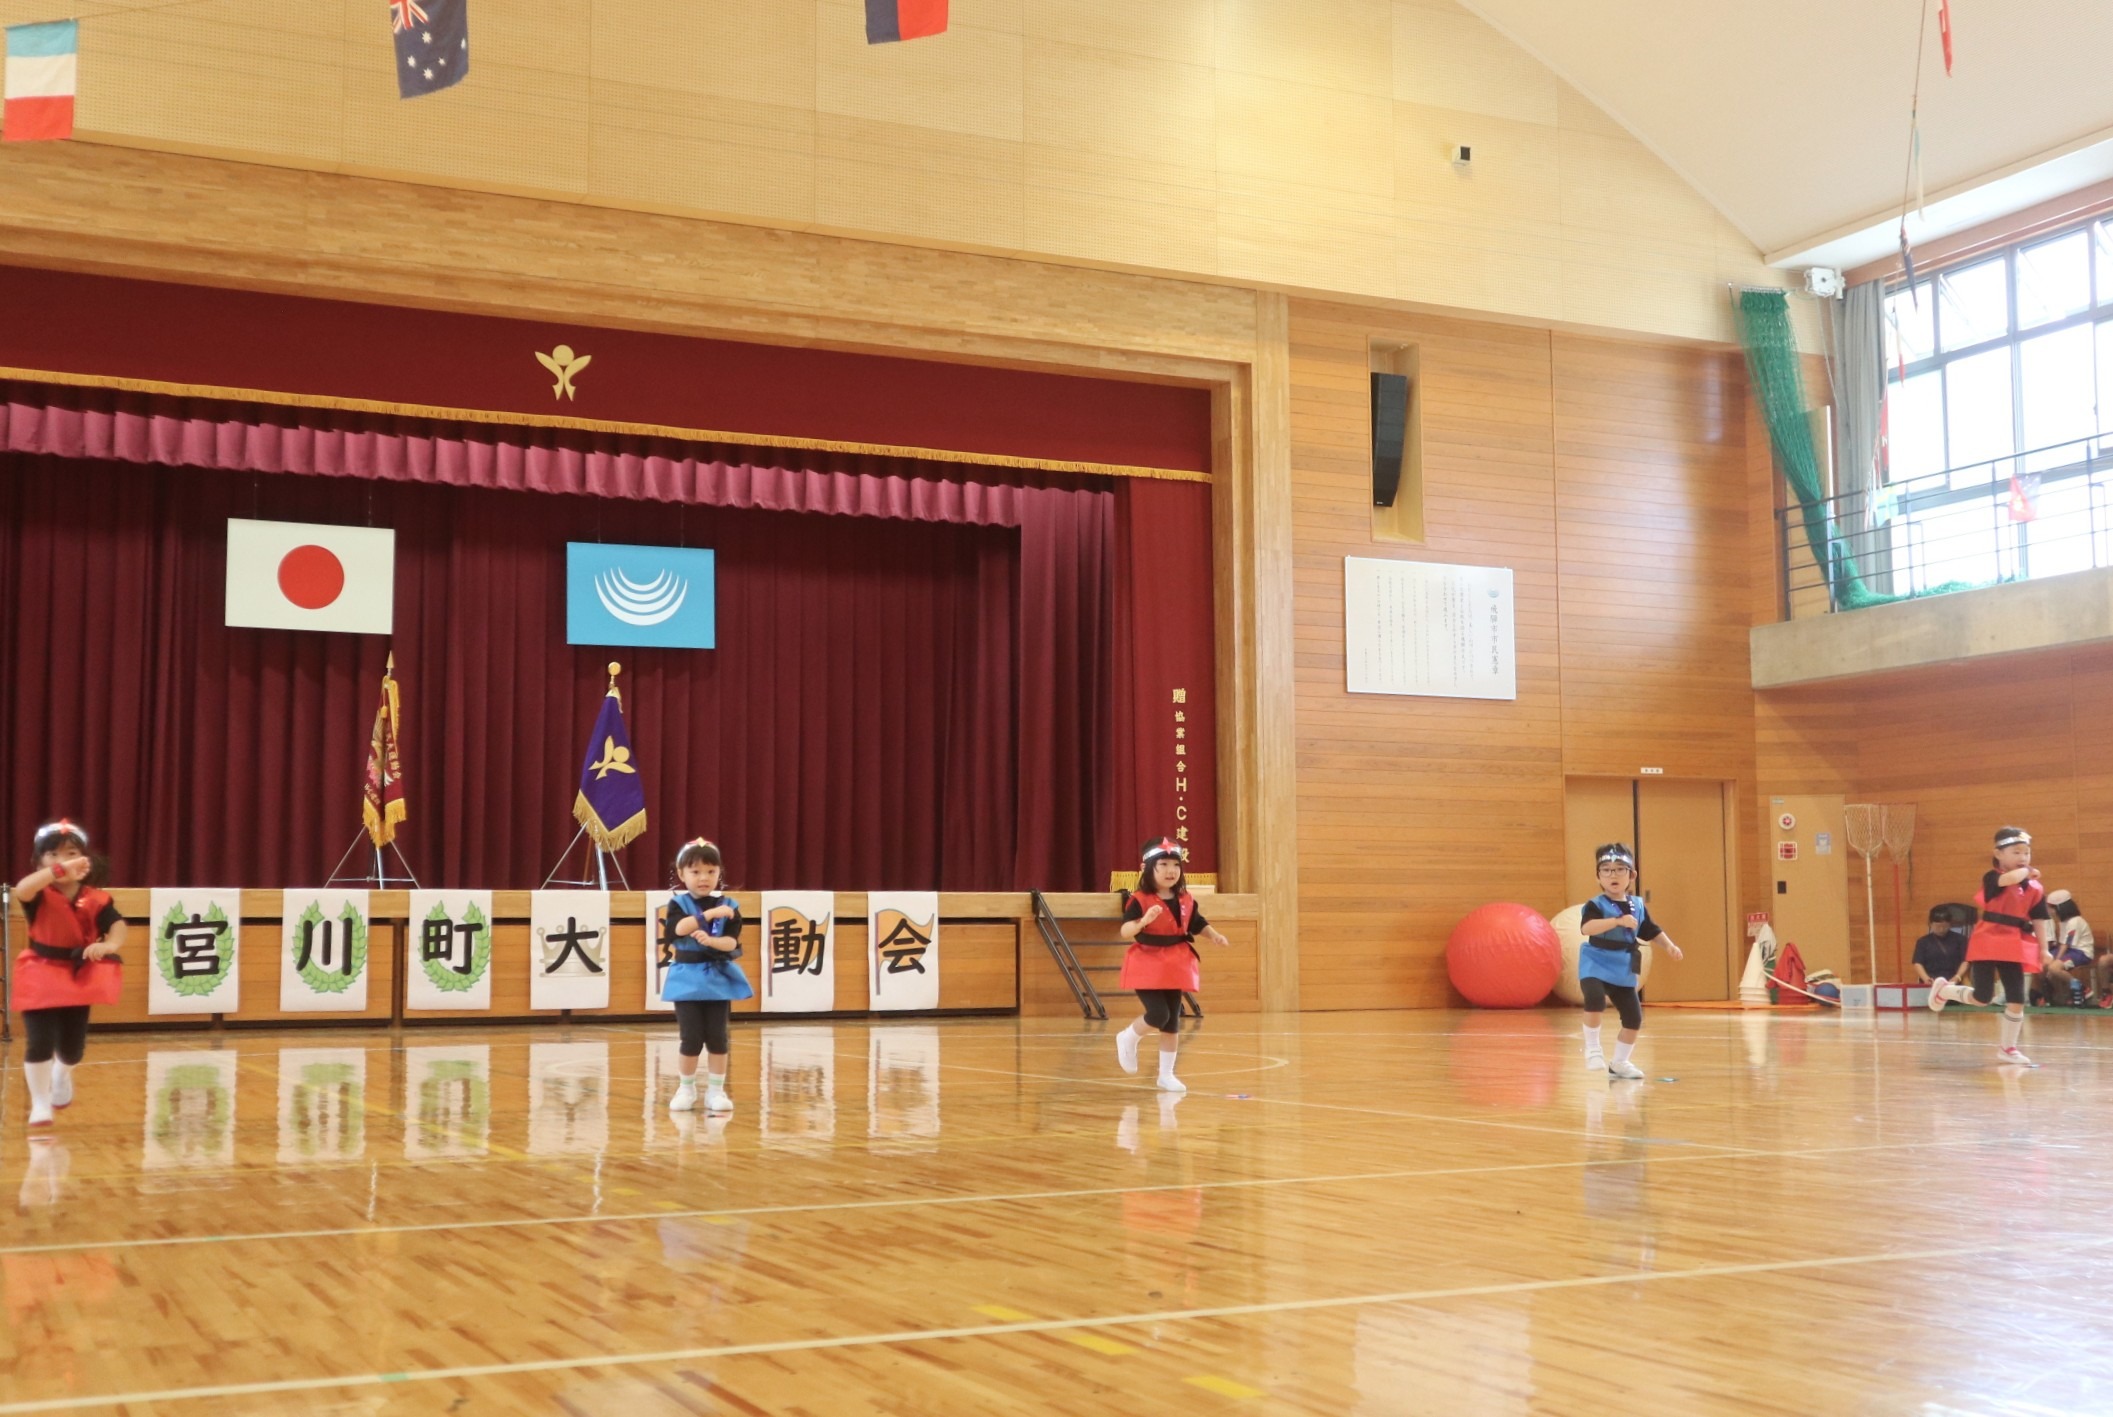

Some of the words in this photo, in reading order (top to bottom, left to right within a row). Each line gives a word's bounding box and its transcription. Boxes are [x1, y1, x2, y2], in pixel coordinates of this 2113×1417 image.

[164, 913, 932, 979] 宮川町大動会
